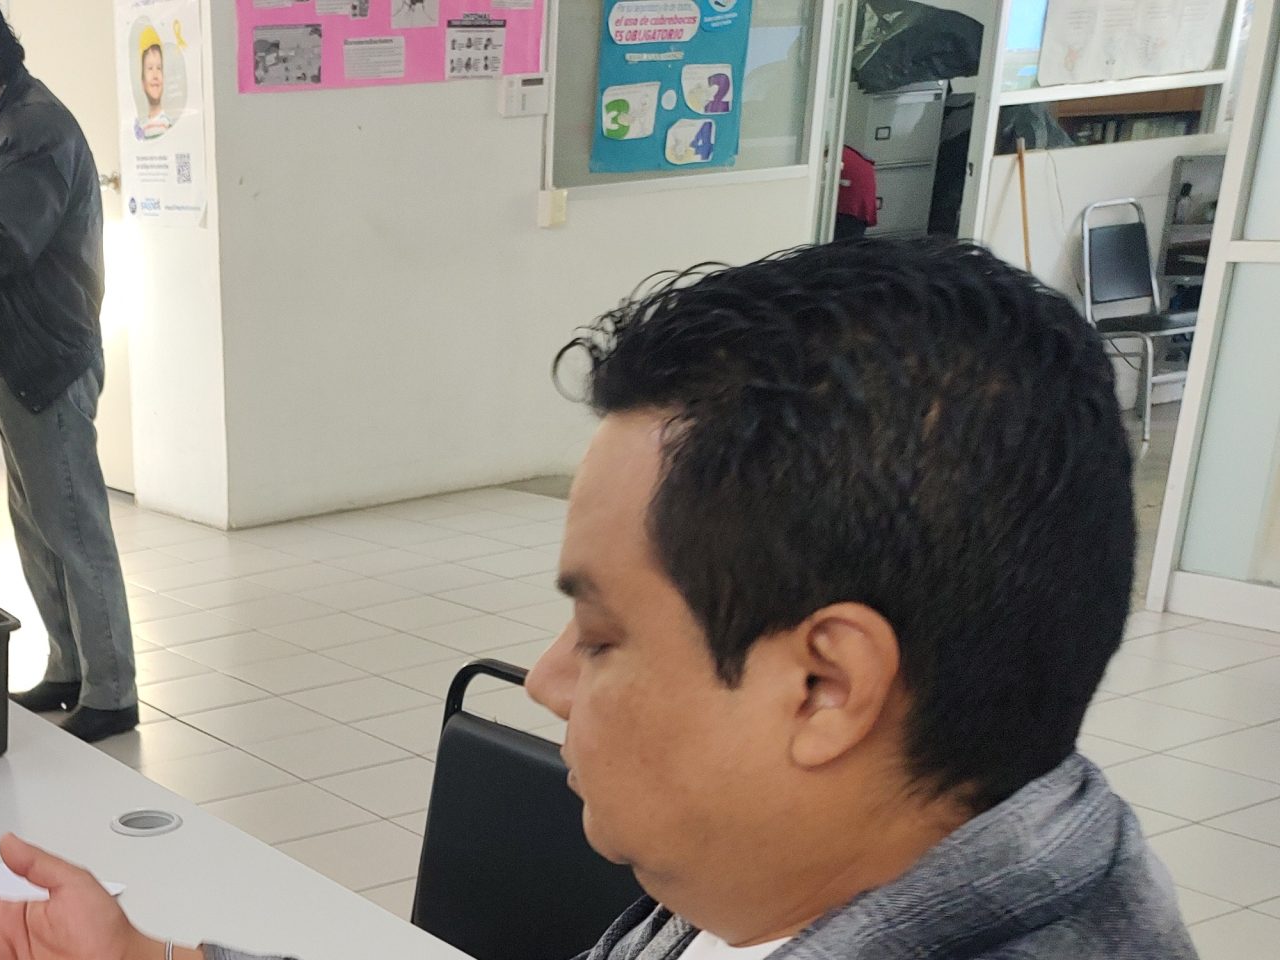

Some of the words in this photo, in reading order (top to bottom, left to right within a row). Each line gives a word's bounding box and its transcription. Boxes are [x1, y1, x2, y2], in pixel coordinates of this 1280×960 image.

[625, 28, 684, 41] OBLIGATORIO
[704, 73, 731, 113] 2
[605, 98, 630, 139] 3
[690, 121, 714, 160] 4
